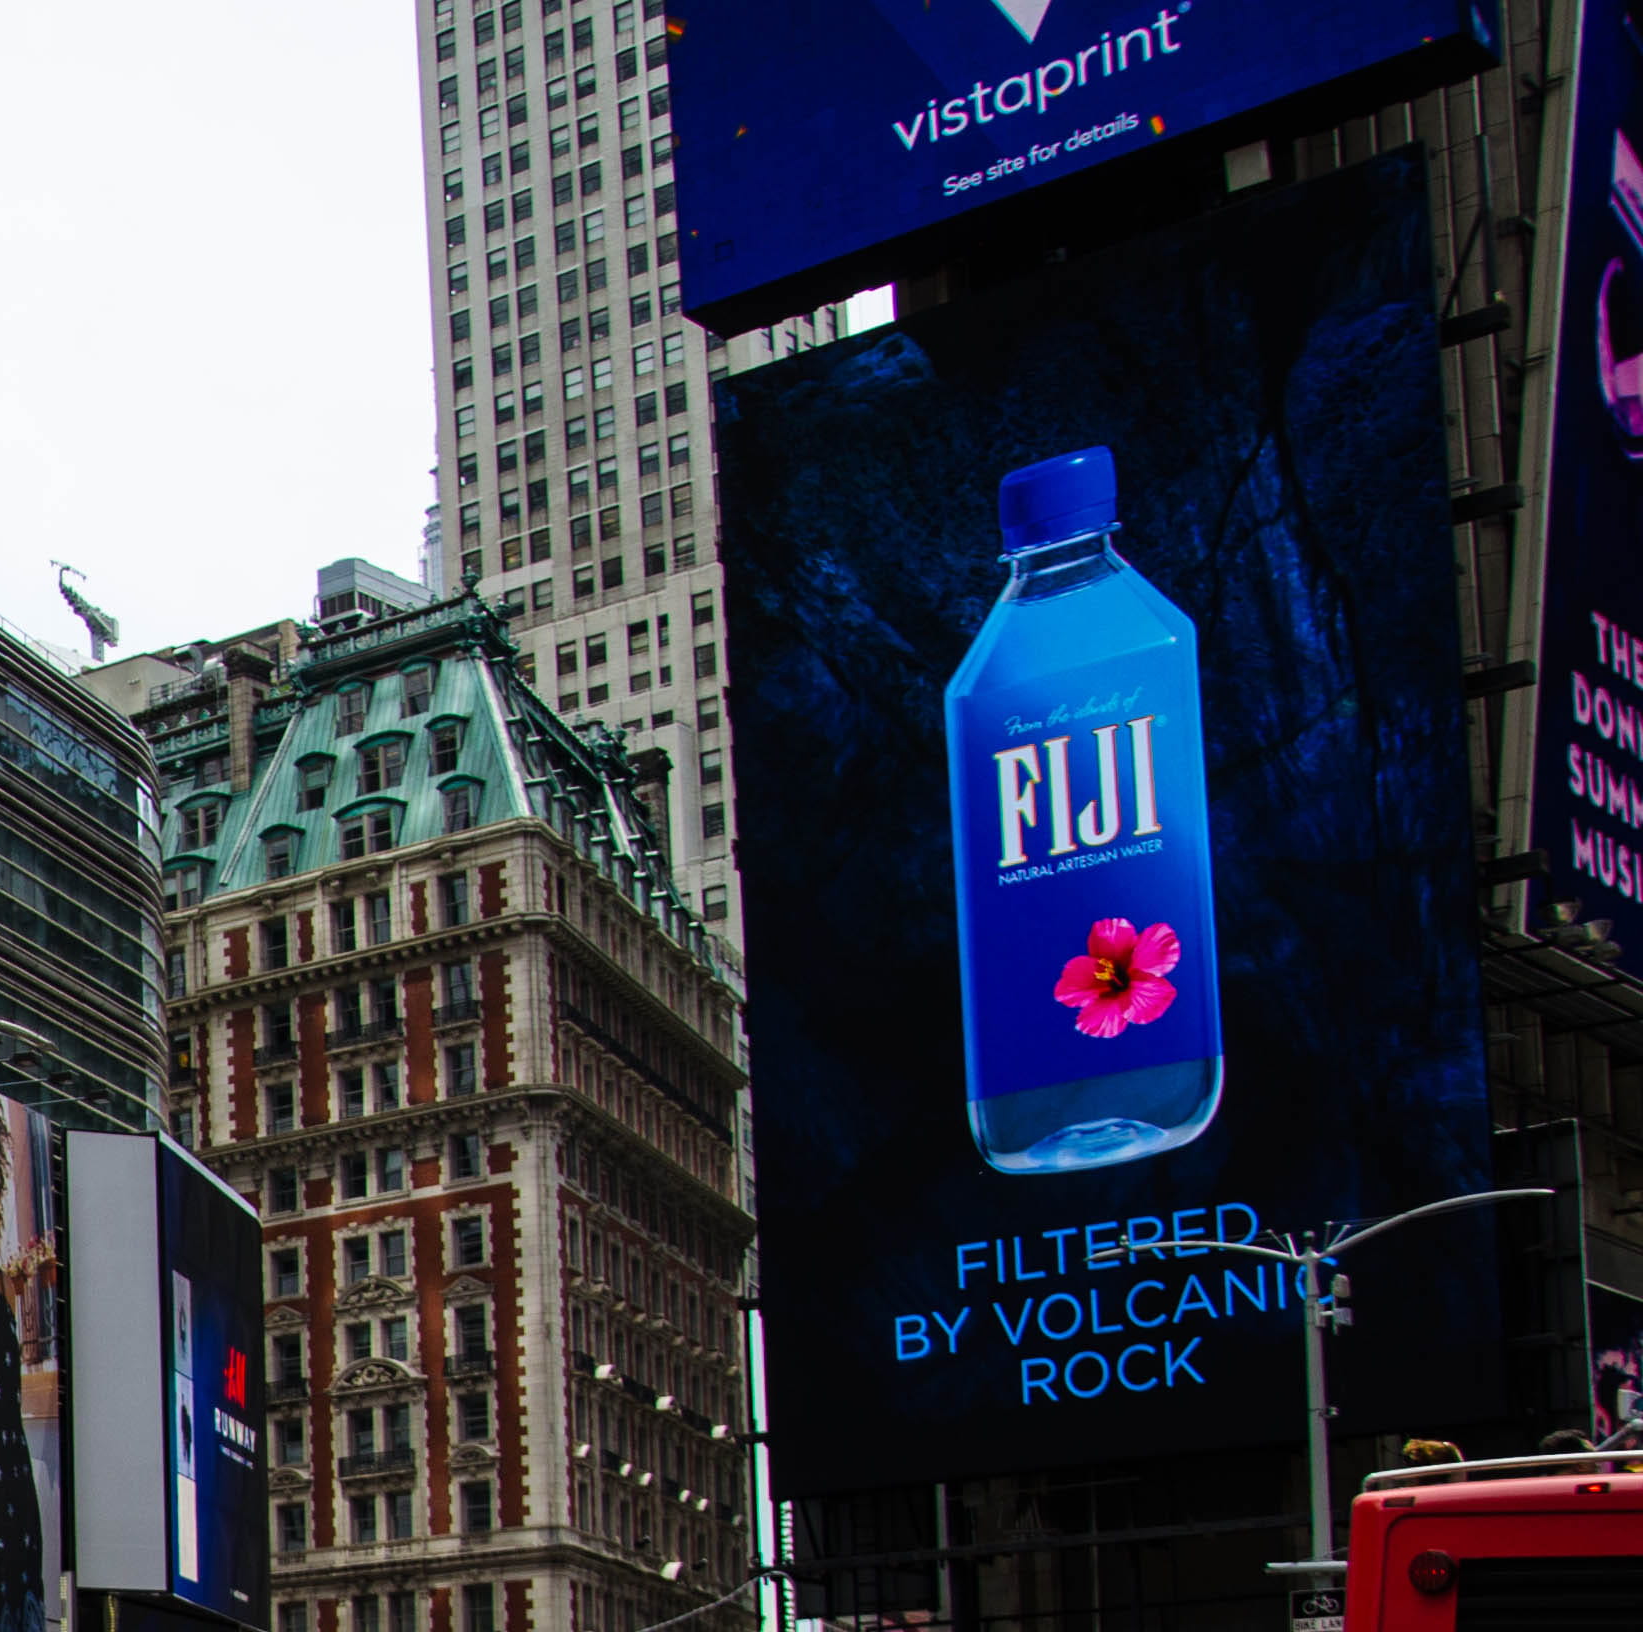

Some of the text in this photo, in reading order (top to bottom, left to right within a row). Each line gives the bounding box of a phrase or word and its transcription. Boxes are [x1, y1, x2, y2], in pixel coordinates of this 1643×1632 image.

[892, 8, 1182, 151] vistaprint
[943, 112, 1139, 197] See site for details
[1590, 609, 1643, 692] THE
[992, 714, 1162, 869] FIJI
[998, 838, 1163, 886] NATURAL ARTESIAN WATER
[956, 1203, 1259, 1289] FILTERED
[895, 1307, 971, 1361] BY
[1021, 1337, 1206, 1404] ROCK
[215, 1407, 256, 1453] RUNWAY
[1321, 1616, 1344, 1629] LAN
